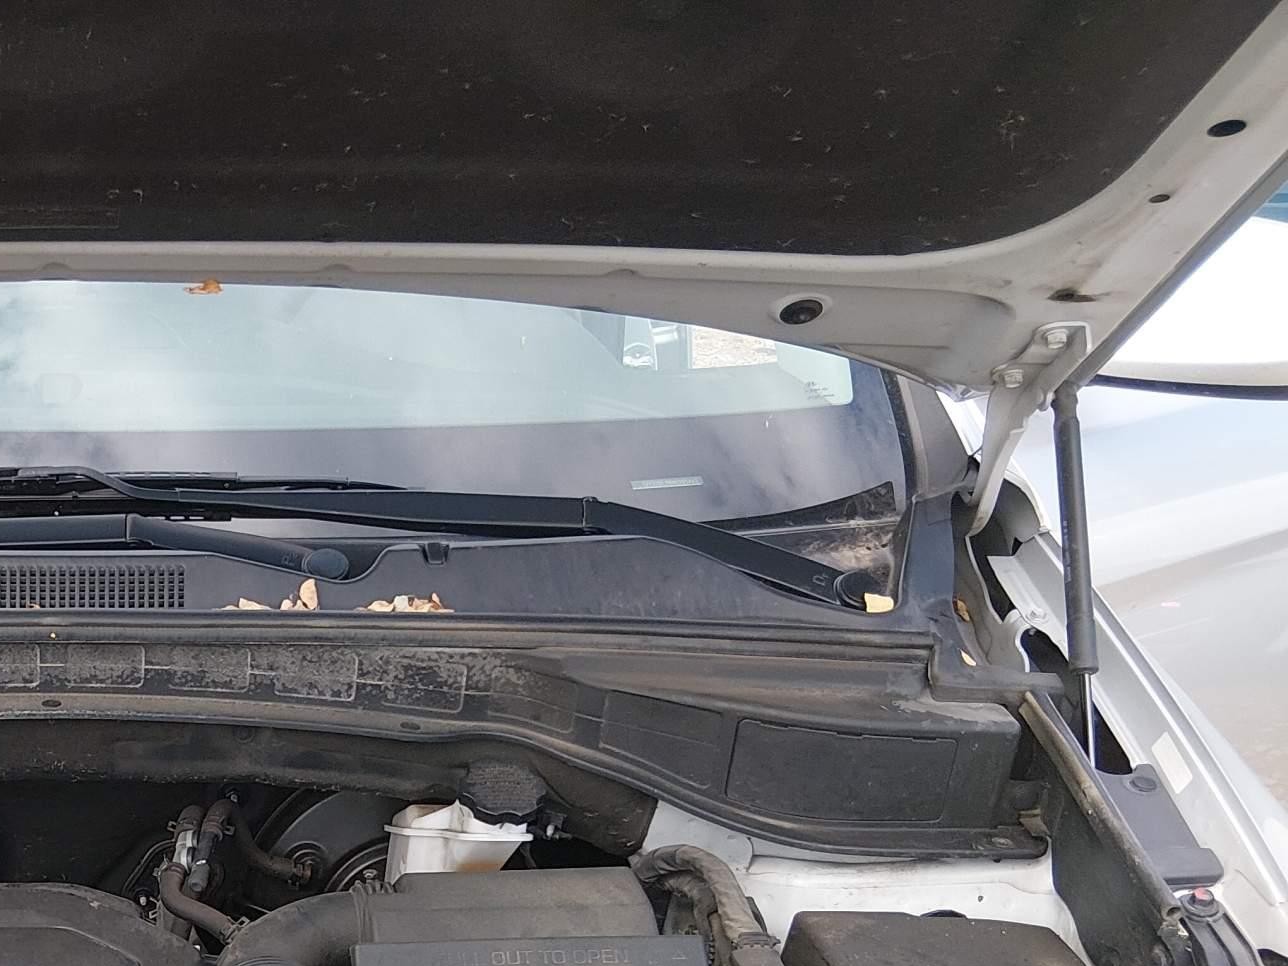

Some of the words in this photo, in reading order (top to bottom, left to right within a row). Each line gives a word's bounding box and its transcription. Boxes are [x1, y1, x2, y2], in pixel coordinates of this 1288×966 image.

[491, 950, 533, 965] OUT
[538, 950, 567, 965] TO
[572, 949, 630, 964] OPEN
